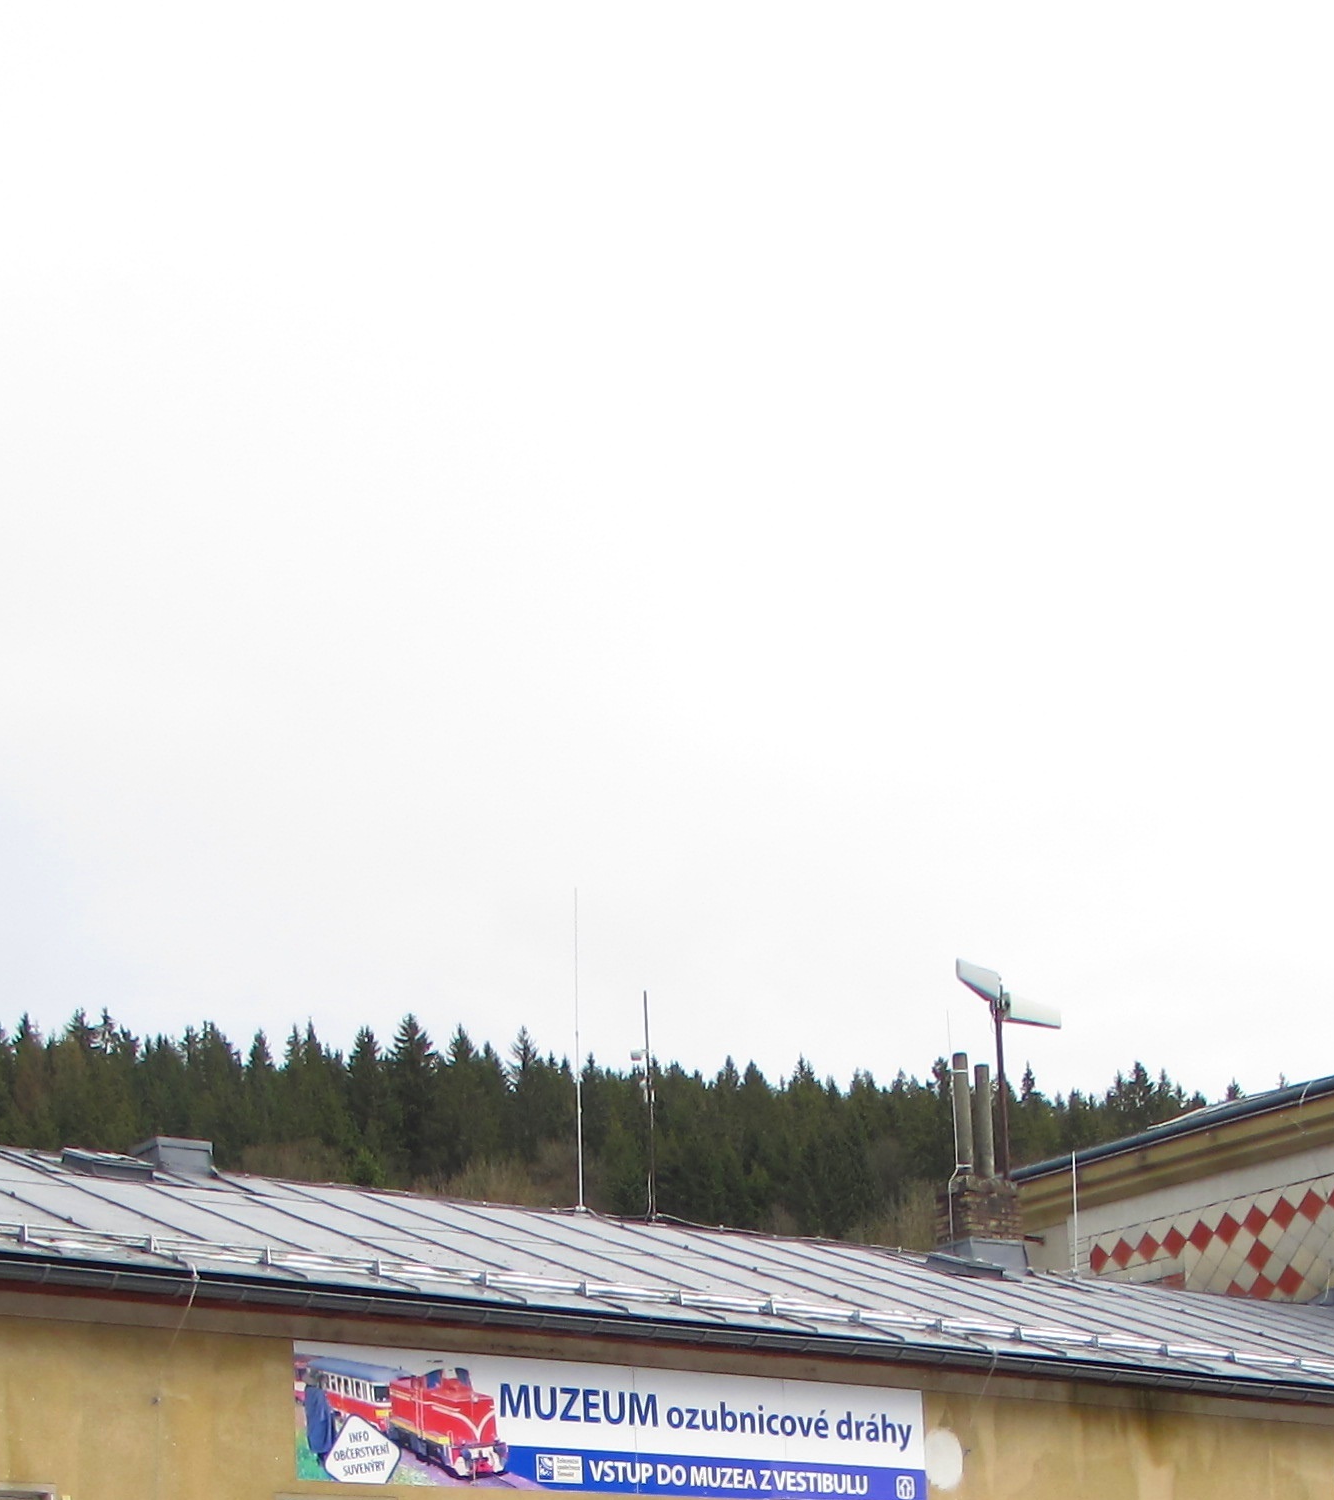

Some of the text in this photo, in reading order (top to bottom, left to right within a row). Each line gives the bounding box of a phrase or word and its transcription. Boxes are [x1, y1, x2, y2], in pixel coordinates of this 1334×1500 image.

[500, 1383, 912, 1452] MUZEUM ozubnicové dráhy
[348, 1431, 370, 1443] INFO
[333, 1442, 390, 1461] OBČERSTVENÍ
[343, 1459, 386, 1476] SUVENÝRY
[589, 1460, 868, 1495] VSTUP DO MUZEA Z VESTIBULU
